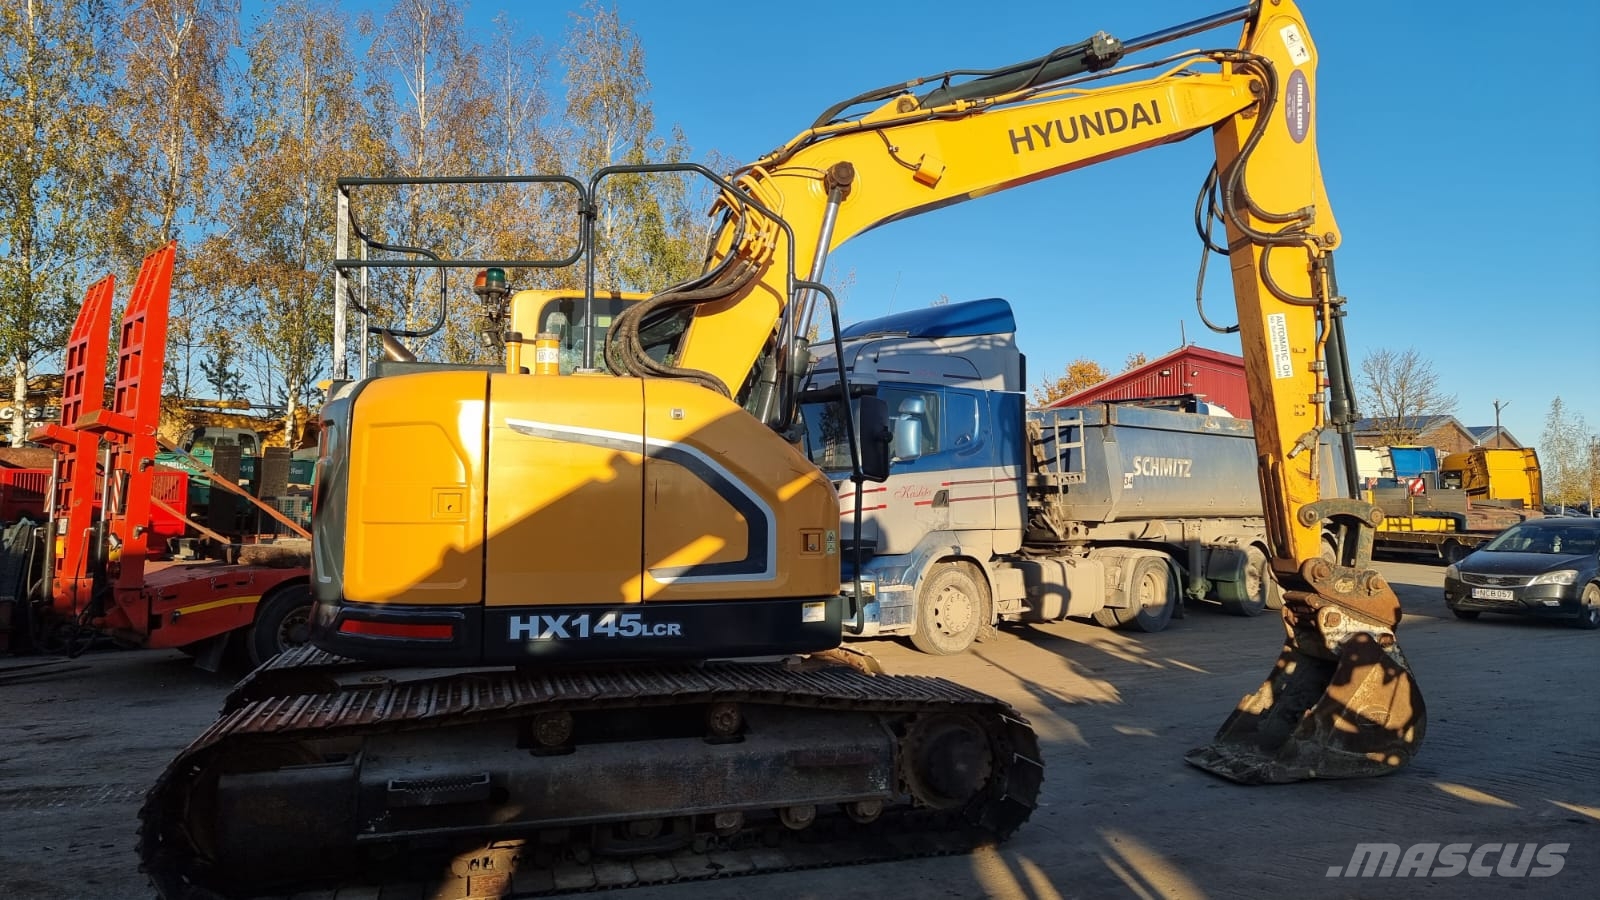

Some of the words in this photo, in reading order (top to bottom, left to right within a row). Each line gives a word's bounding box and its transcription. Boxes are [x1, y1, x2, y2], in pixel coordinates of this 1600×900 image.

[1008, 99, 1162, 154] HYUNDAI
[1276, 315, 1289, 361] AUTOMATIC
[0, 407, 56, 419] CSE
[1132, 455, 1193, 478] SCHMITZ
